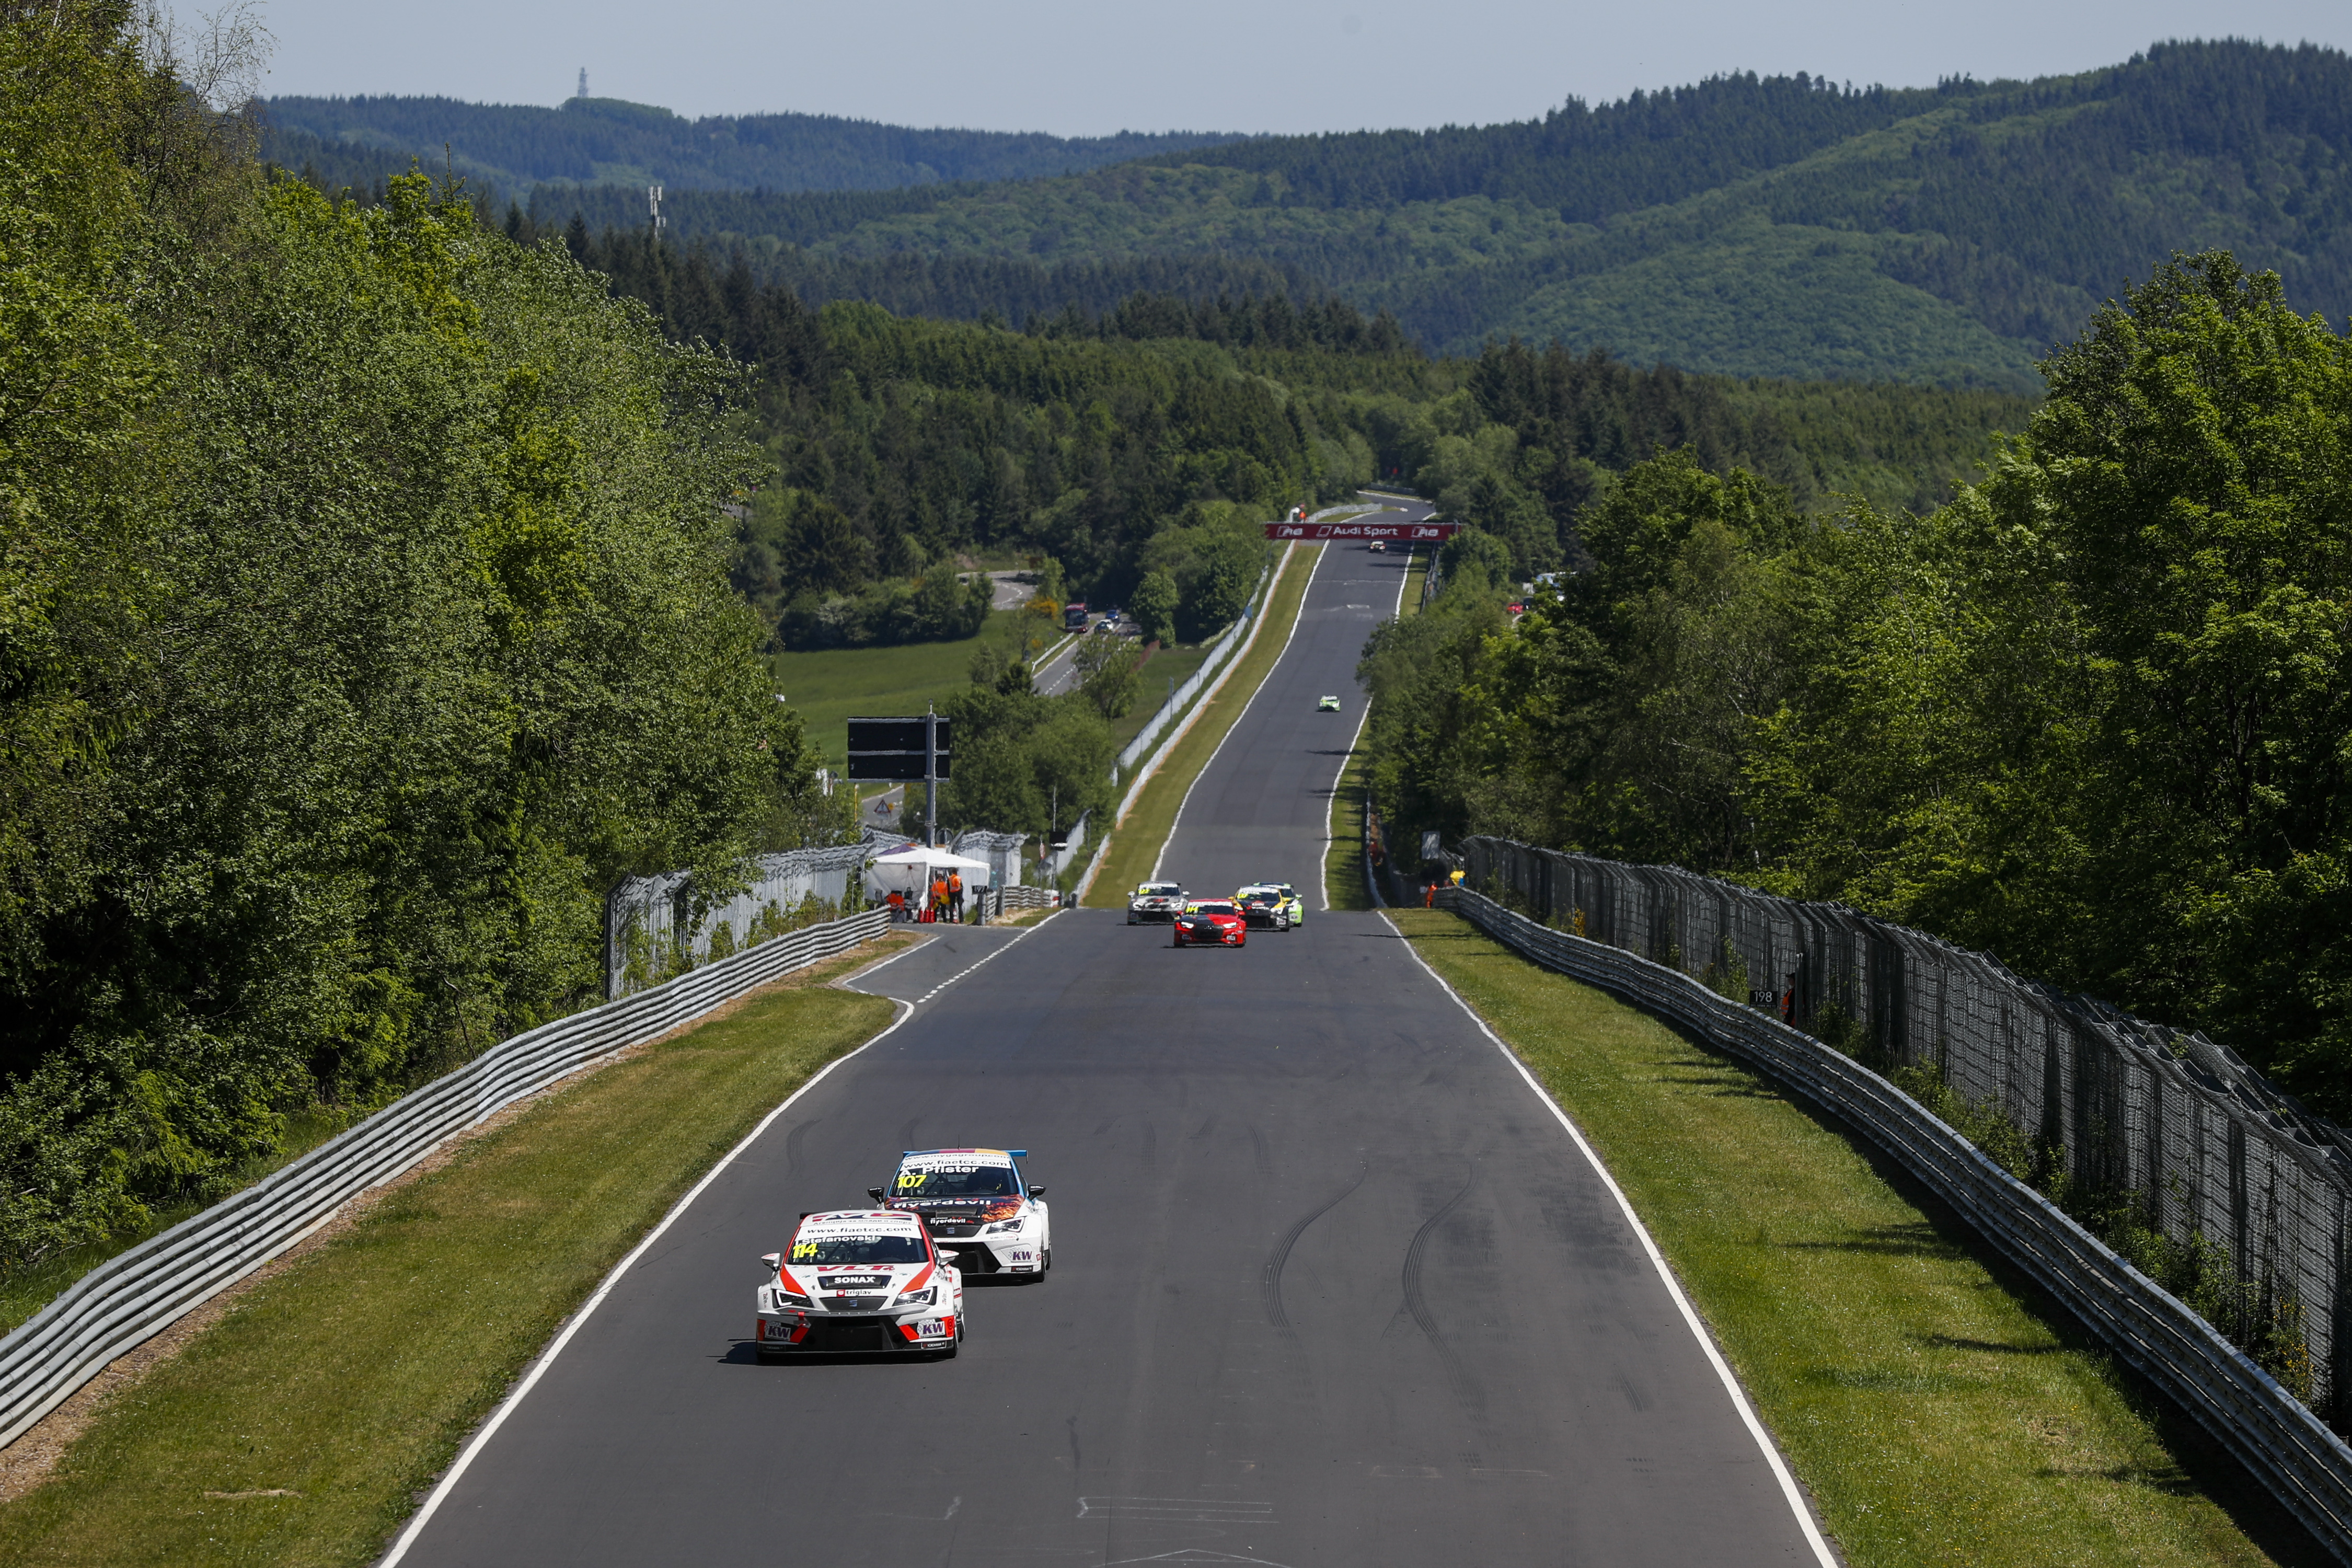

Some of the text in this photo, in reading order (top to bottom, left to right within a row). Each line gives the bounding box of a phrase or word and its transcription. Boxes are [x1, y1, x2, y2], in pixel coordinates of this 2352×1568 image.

[1333, 526, 1399, 537] Audi Sport
[1754, 991, 1772, 1002] 198
[904, 1160, 1007, 1168] www.fiaetcc.com
[899, 1166, 979, 1178] A. Pfister
[897, 1175, 927, 1188] 107
[792, 1243, 818, 1259] 114
[1012, 1251, 1032, 1261] KW
[768, 1325, 790, 1338] KW
[923, 1322, 943, 1334] KW
